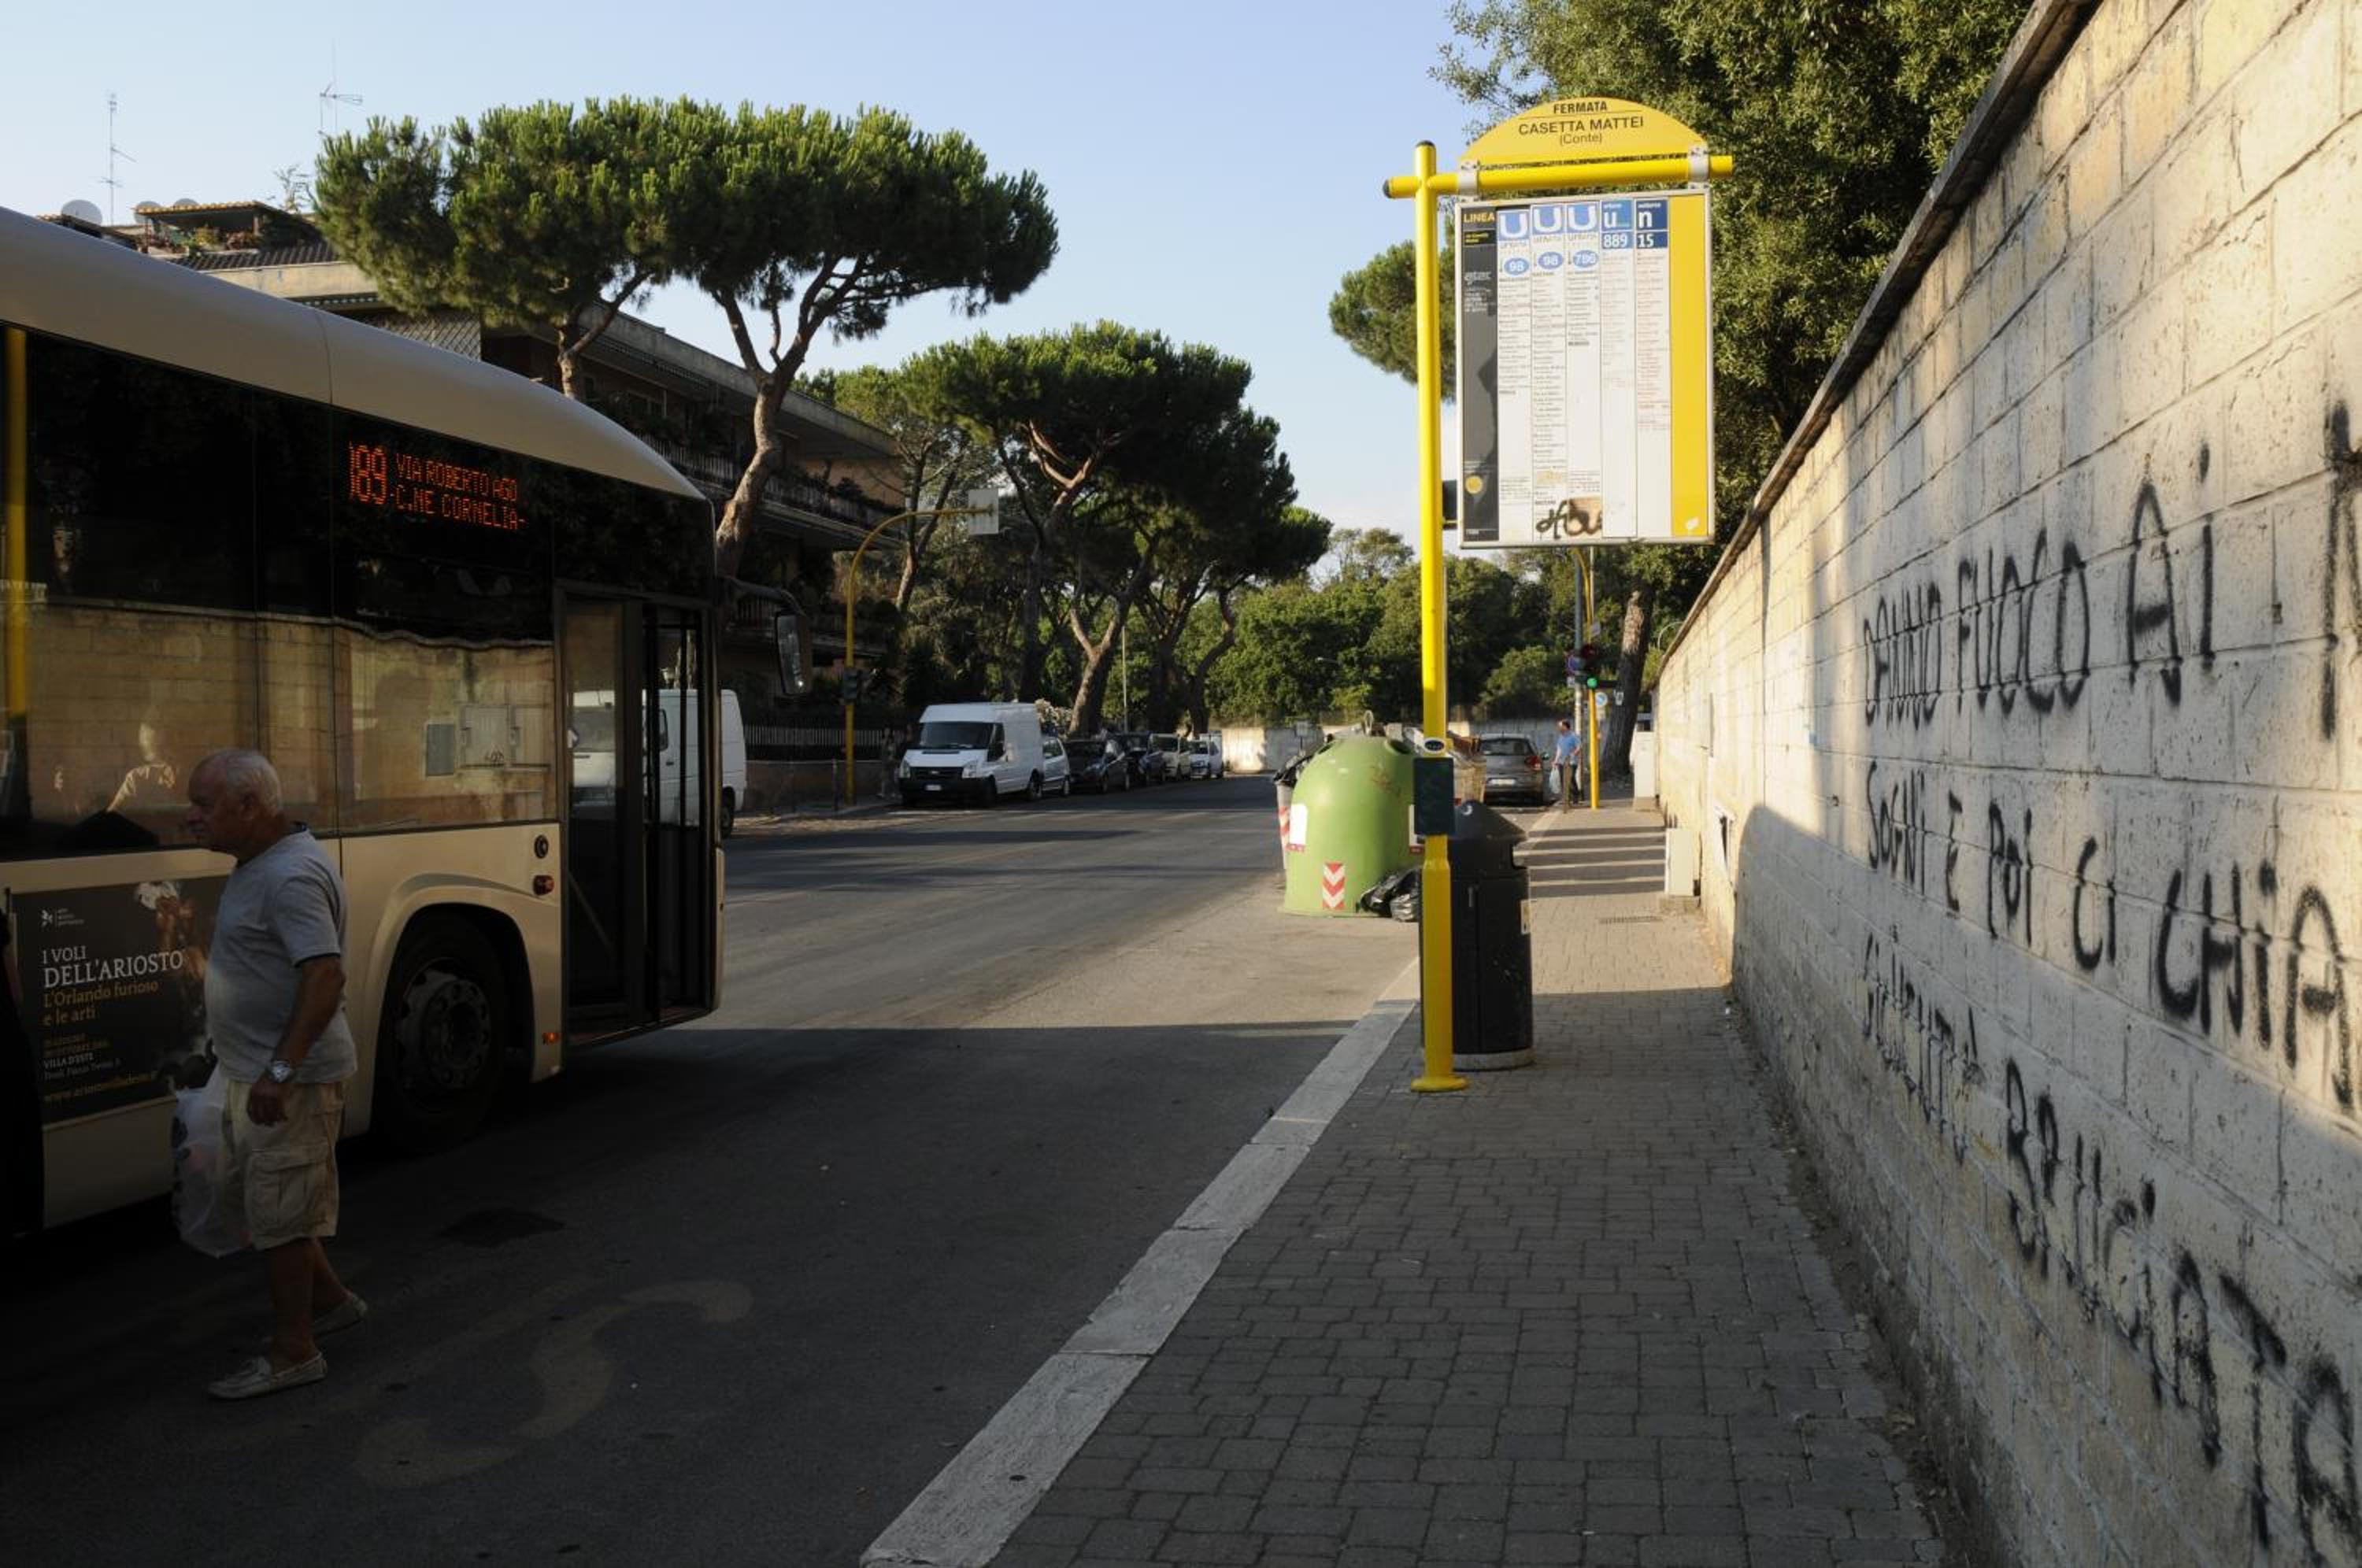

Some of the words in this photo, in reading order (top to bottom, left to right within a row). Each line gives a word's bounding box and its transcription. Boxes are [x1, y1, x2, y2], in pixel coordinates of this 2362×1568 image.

[1553, 101, 1608, 115] FERMATA
[1518, 120, 1586, 136] CASETTA
[1590, 116, 1644, 131] MATTEI
[1560, 132, 1602, 146] (Conte)
[1464, 211, 1495, 224] LINEA
[1604, 233, 1627, 248] 889
[1638, 233, 1654, 248] 15
[396, 453, 424, 483] VIA
[426, 460, 489, 496] ROBERTO
[442, 494, 518, 530] CORNELIA
[1957, 528, 2090, 714] FUOCO
[50, 945, 87, 963] VOLI
[44, 949, 183, 989] DELL'ARIOSTO
[44, 986, 111, 1008] L'Orlando
[114, 980, 158, 1000] furioso
